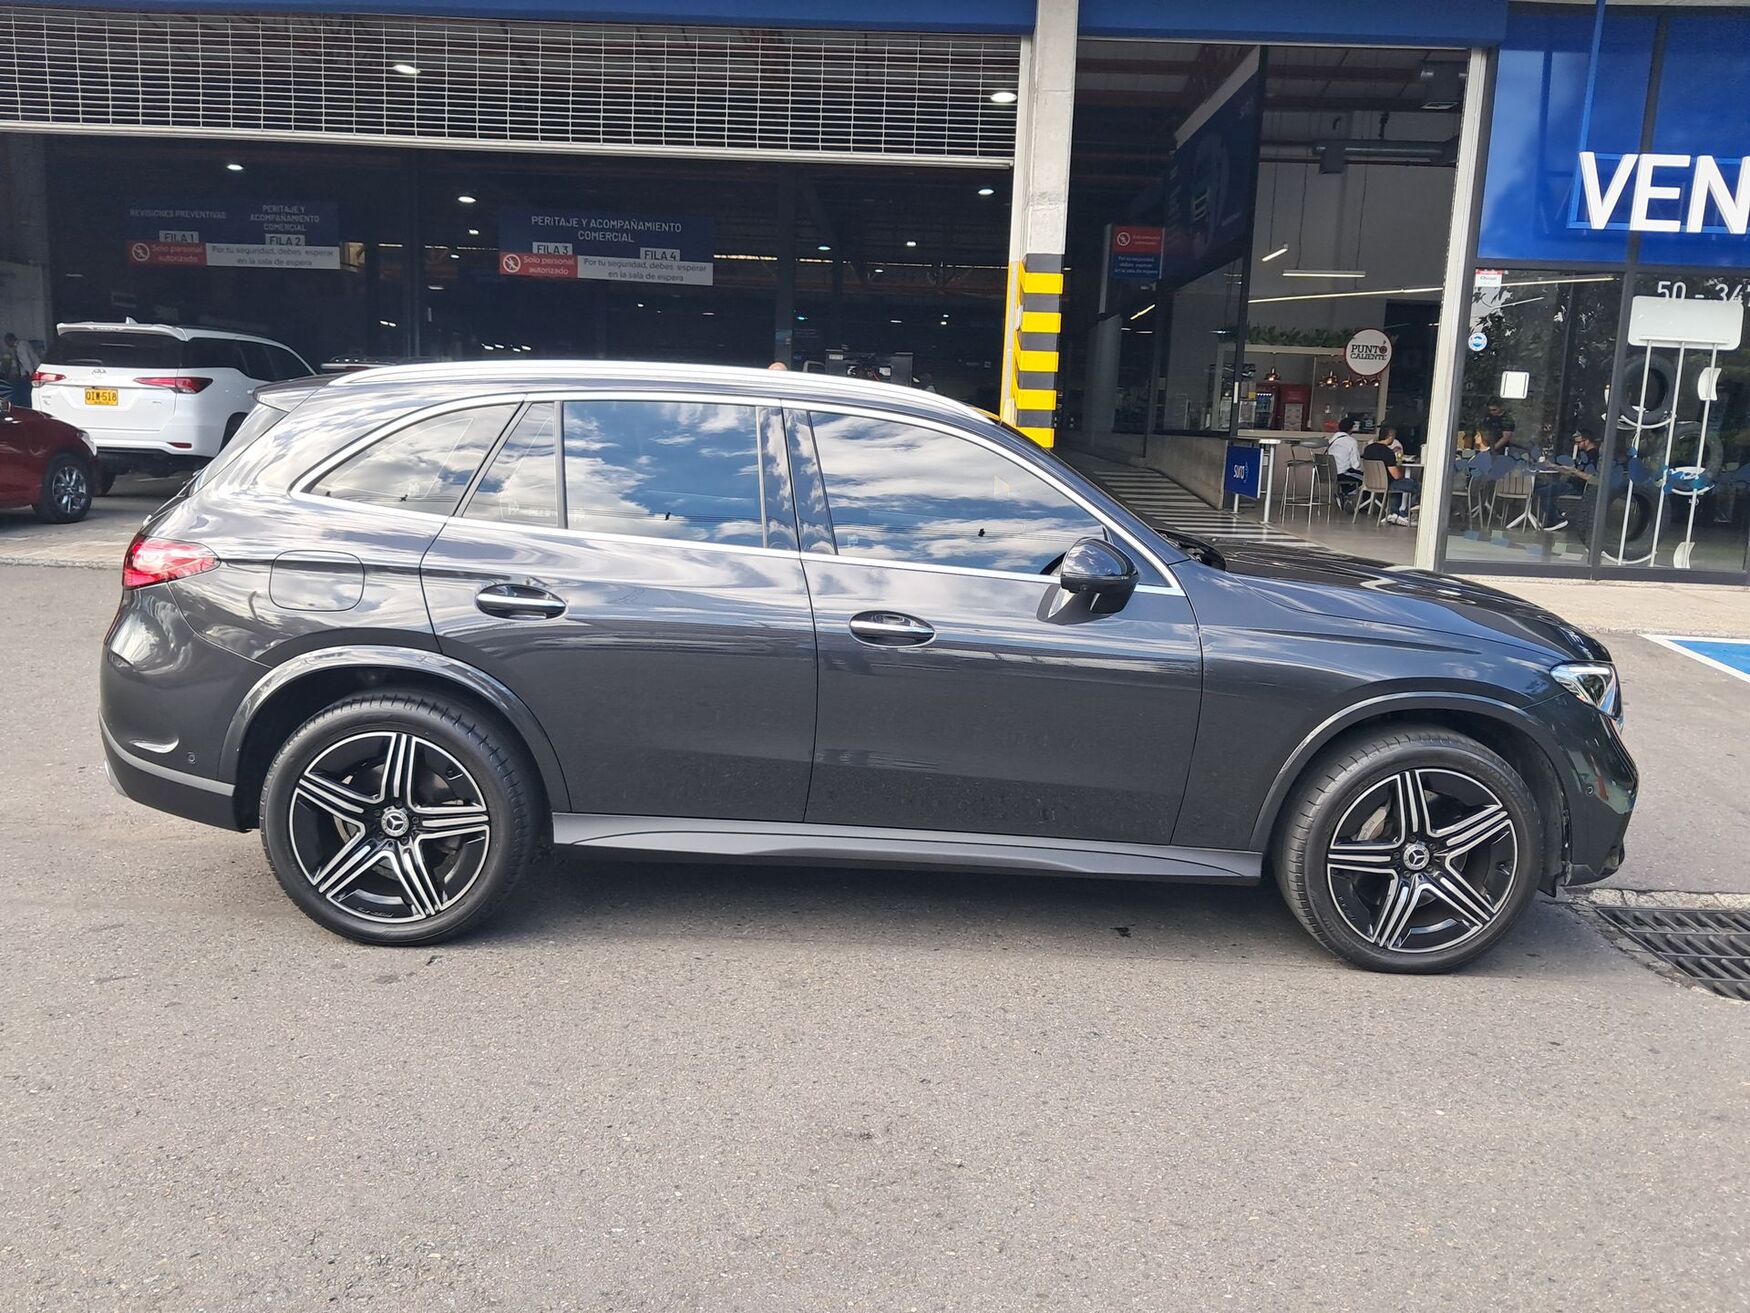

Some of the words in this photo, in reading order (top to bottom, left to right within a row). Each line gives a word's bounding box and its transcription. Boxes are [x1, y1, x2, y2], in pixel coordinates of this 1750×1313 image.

[1579, 151, 1750, 234] VEN
[262, 205, 299, 213] PERITAJE
[531, 216, 579, 228] PERITAJE
[581, 218, 588, 228] Y
[590, 218, 682, 233] ACOMPAÑAMIENTO
[164, 232, 188, 241] FILA
[270, 235, 293, 245] FILA
[295, 236, 302, 246] 2
[578, 230, 635, 243] COMERCIAL
[537, 244, 560, 254] FILA
[562, 245, 569, 255] 3
[523, 255, 540, 264] Solo
[644, 249, 668, 261] FILA
[670, 251, 677, 262] 4
[645, 271, 656, 280] de
[1351, 344, 1388, 354] PUNTO
